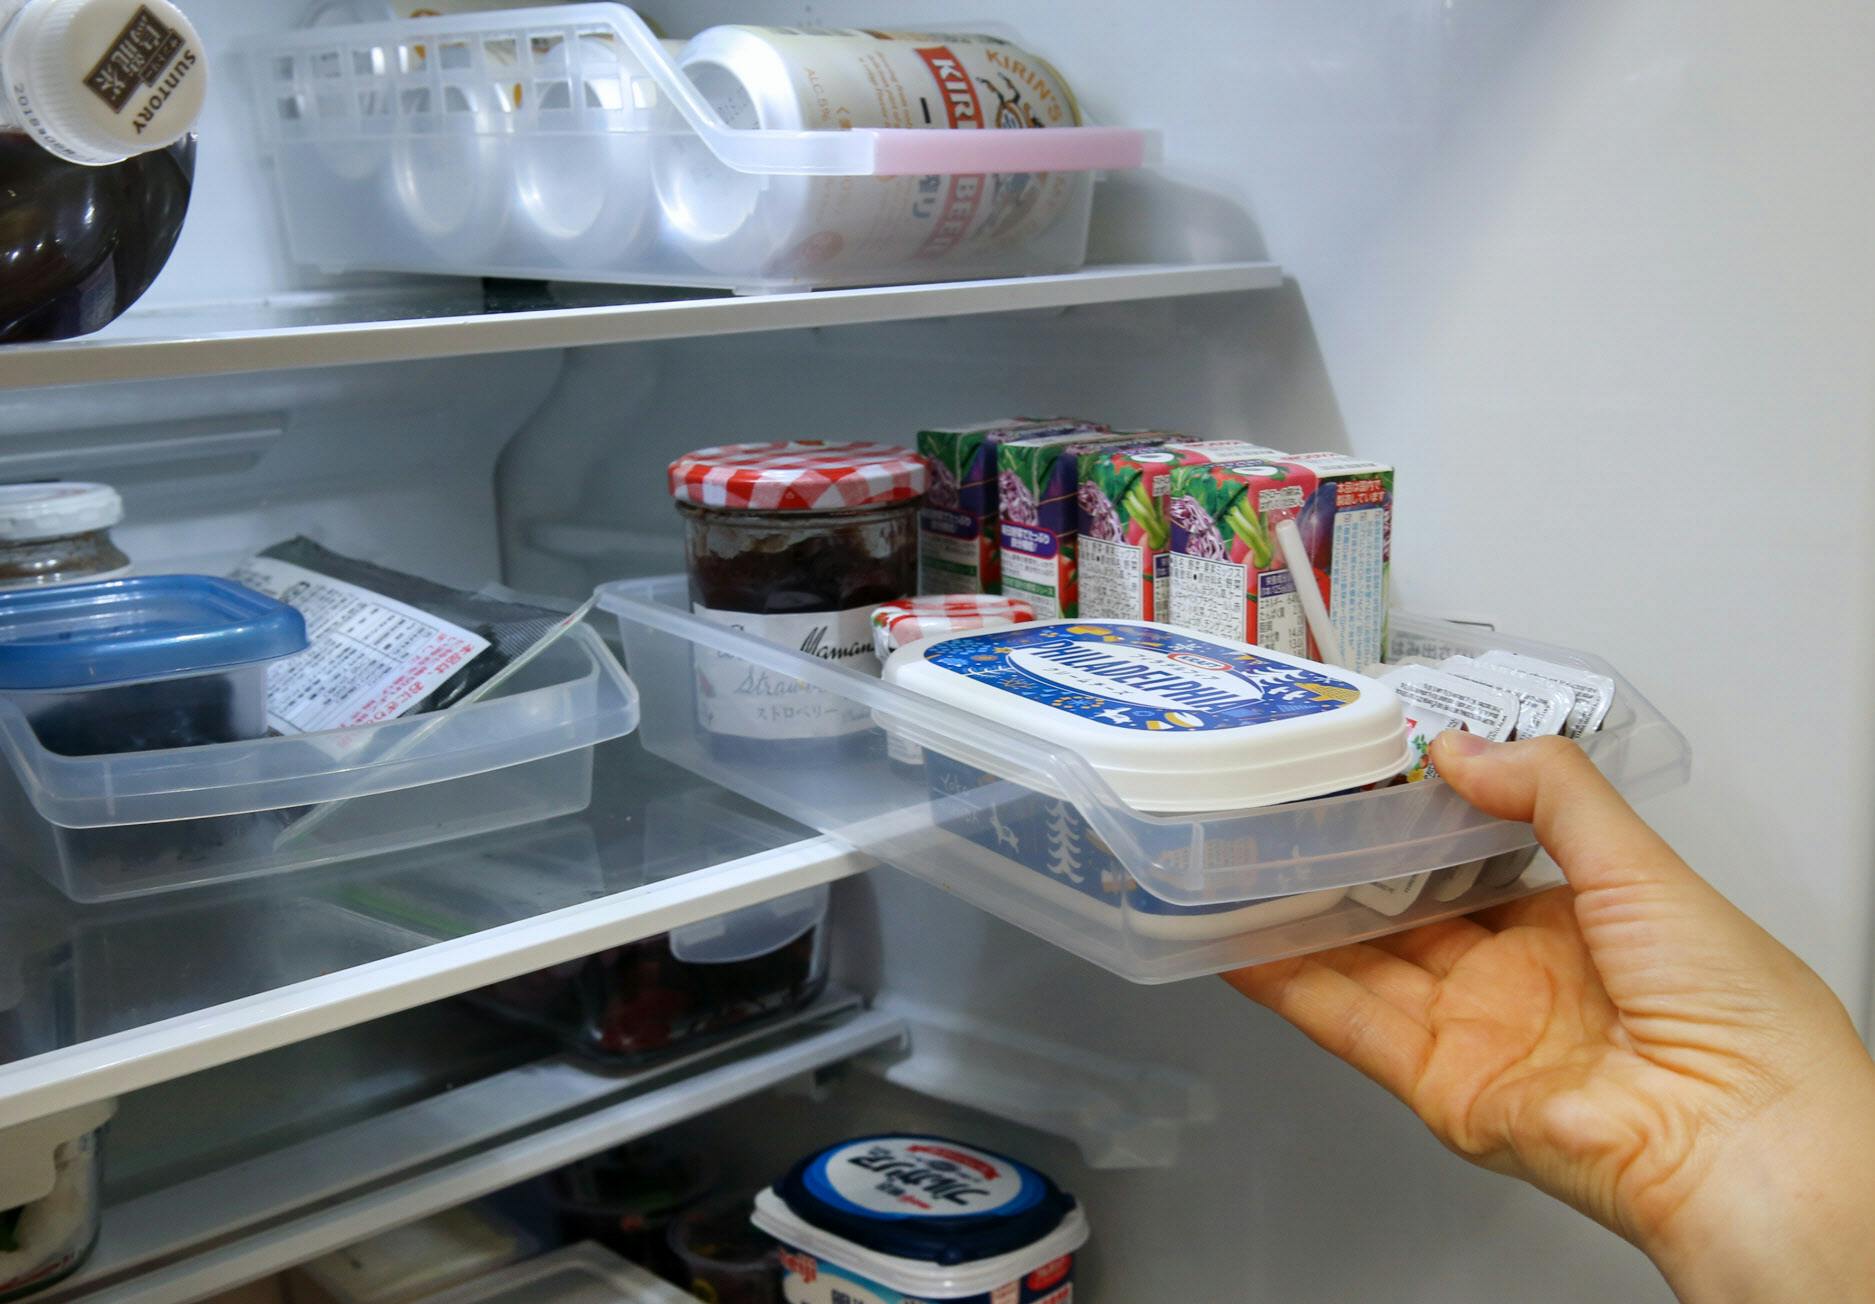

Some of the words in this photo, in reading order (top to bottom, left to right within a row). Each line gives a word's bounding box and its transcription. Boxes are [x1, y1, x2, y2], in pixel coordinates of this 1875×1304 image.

[132, 49, 197, 135] SUNTORY
[1013, 640, 1257, 711] PHILADELPHIA
[757, 704, 838, 721] ストロベリー
